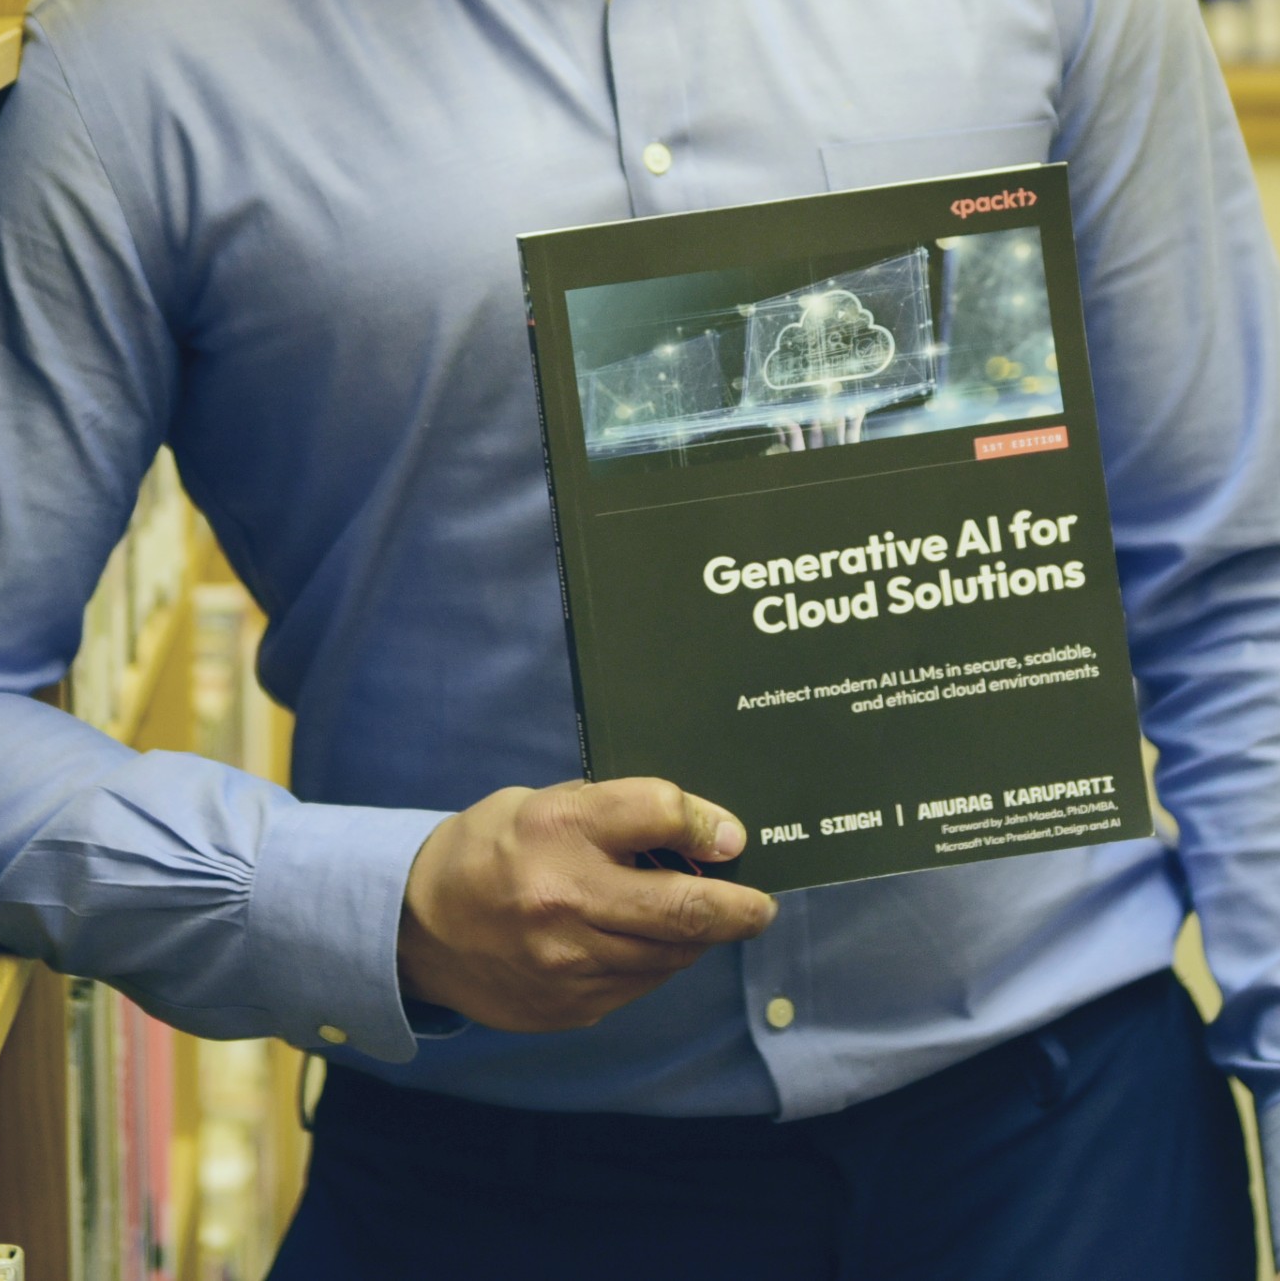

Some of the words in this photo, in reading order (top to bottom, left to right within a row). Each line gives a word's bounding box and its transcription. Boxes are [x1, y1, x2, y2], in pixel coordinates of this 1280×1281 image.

[1011, 433, 1062, 449] EDITION
[703, 531, 948, 594] Generative
[957, 516, 1002, 557] AI
[1009, 510, 1077, 549] for
[753, 581, 878, 633] Cloud
[887, 561, 1085, 614] Solutions
[737, 686, 811, 710] Architect
[814, 678, 877, 698] modern
[880, 672, 897, 688] AI
[900, 666, 944, 686] LLMs
[946, 663, 961, 677] in
[963, 657, 1022, 679] secure,
[1024, 644, 1096, 666] scalable,
[851, 694, 883, 713] and
[886, 685, 939, 707] ethical
[942, 678, 986, 698] cloud
[988, 664, 1099, 691] environments
[761, 823, 809, 845] PAUL
[820, 810, 882, 835] SINGH
[918, 794, 993, 820] ANURAG
[1003, 776, 1115, 807] KARUPARTI
[935, 838, 984, 853] Microsoft
[984, 835, 1006, 845] Vice
[1006, 827, 1055, 842] President,
[1055, 824, 1090, 836] Design
[1090, 819, 1110, 831] and
[1110, 818, 1121, 828] AI
[941, 819, 990, 834] Foreword
[990, 818, 1003, 828] by
[1004, 814, 1028, 825] John
[1028, 808, 1067, 821] Maeda,
[1067, 800, 1118, 815] PhD/MBA,
